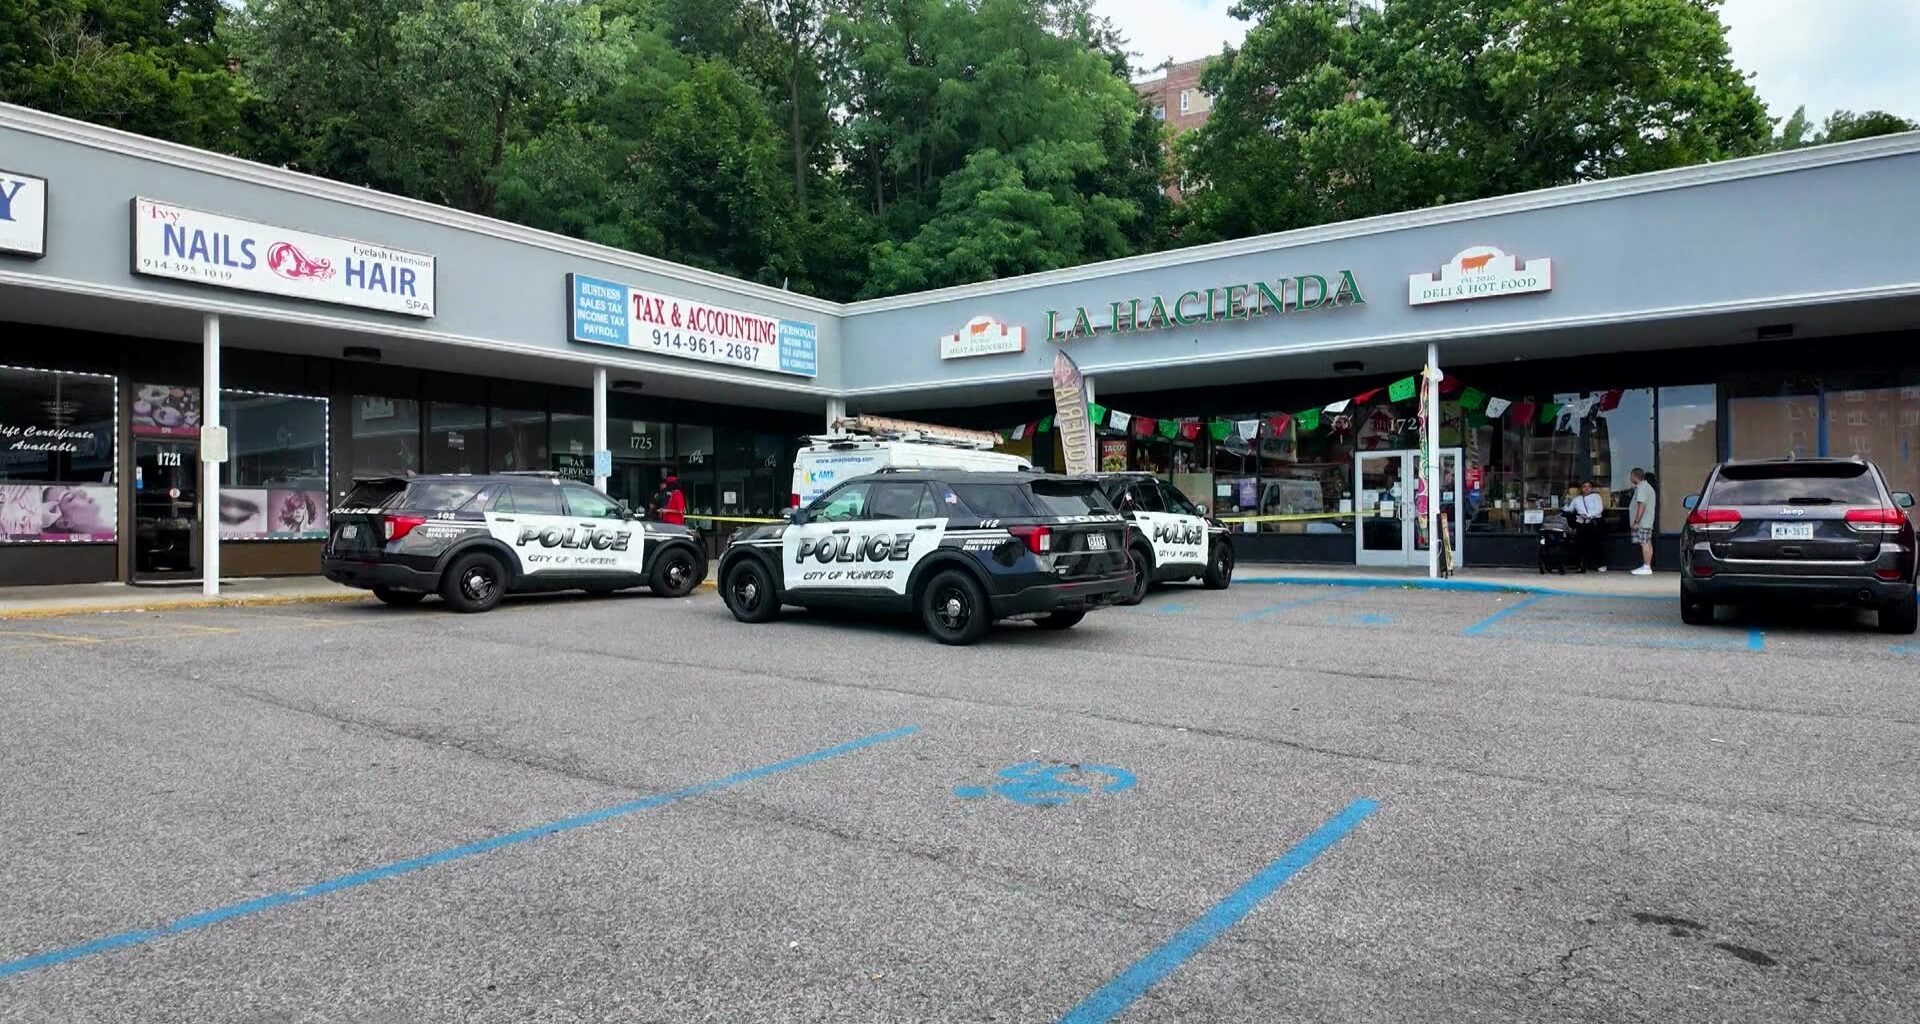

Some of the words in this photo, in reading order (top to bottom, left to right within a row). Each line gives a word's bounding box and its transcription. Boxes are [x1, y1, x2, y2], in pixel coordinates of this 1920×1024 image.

[142, 204, 180, 226] Ivy
[164, 223, 257, 271] NAILS
[353, 246, 387, 260] Eyelash
[389, 253, 431, 268] Extension
[345, 256, 416, 297] HAIR
[582, 282, 621, 301] BUSINESS
[1424, 288, 1452, 299] DELI
[1455, 283, 1464, 295] &
[1469, 282, 1497, 293] HOT
[1501, 278, 1537, 289] FOOD
[405, 299, 430, 312] SPA
[580, 297, 606, 311] SALES
[608, 302, 623, 314] TAX
[1044, 306, 1097, 343] LA
[1109, 270, 1368, 334] HACIENDA
[577, 308, 608, 324] INCOME
[610, 315, 625, 327] TAX
[633, 293, 665, 325] TAX
[671, 302, 682, 328] &
[687, 306, 777, 346] ACCOUNTING
[584, 323, 619, 338] PAYROLL
[779, 323, 817, 340] PERSONAL
[652, 329, 760, 362] 914-961-2687
[950, 346, 968, 354] MEAT
[23, 426, 95, 440] Certificate
[1388, 418, 1418, 434] 172
[10, 440, 77, 453] Available
[630, 437, 652, 449] 1725
[1103, 444, 1126, 453] TACOS
[158, 452, 181, 467] 1721
[569, 459, 585, 468] TAX
[437, 511, 457, 520] 102
[1780, 508, 1805, 516] Jeep
[979, 519, 1000, 528] 112
[516, 525, 632, 552] POLICE
[1153, 522, 1203, 546] POLICE
[795, 533, 916, 564] POLICE
[555, 555, 569, 563] OF
[803, 571, 827, 580] CITY
[828, 571, 843, 579] OF
[846, 570, 895, 580] YONKERS
